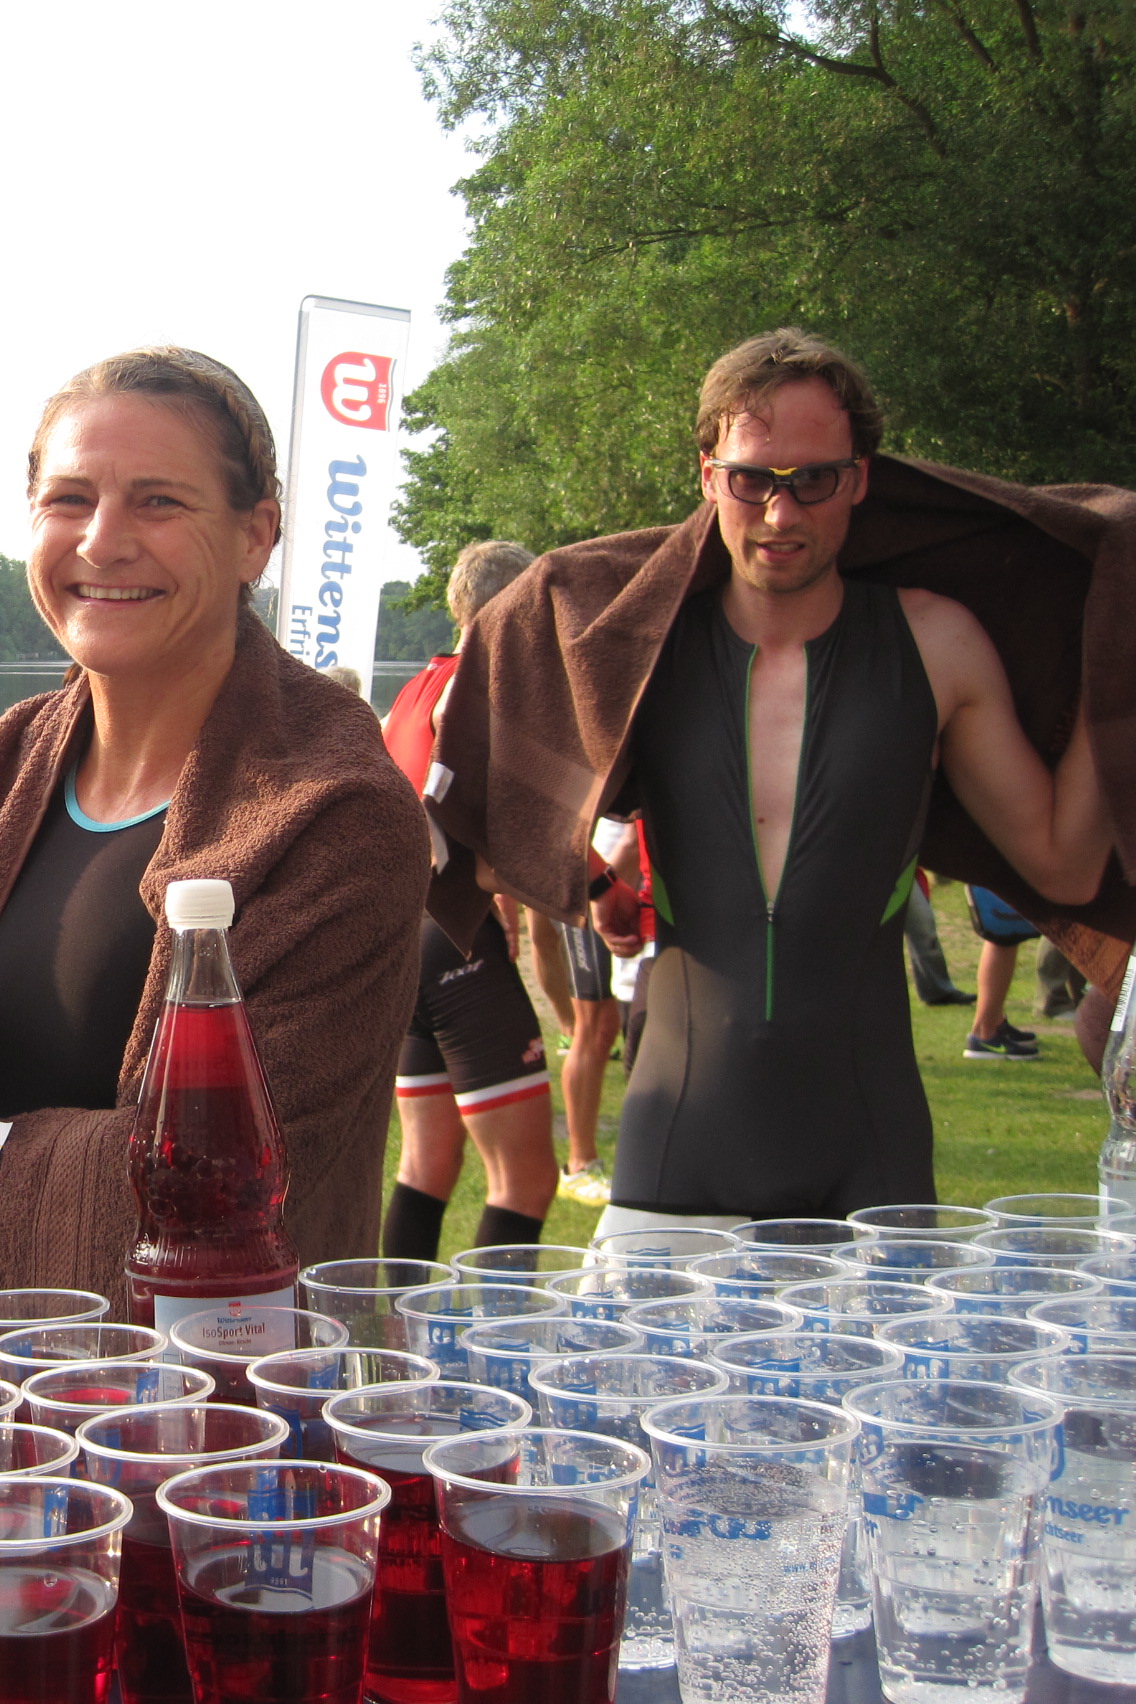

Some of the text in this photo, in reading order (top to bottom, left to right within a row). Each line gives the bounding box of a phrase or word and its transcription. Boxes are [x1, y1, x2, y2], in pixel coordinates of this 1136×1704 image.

[377, 382, 387, 404] 1896
[289, 605, 313, 662] Erfri
[202, 1322, 265, 1340] IsoSport Vital
